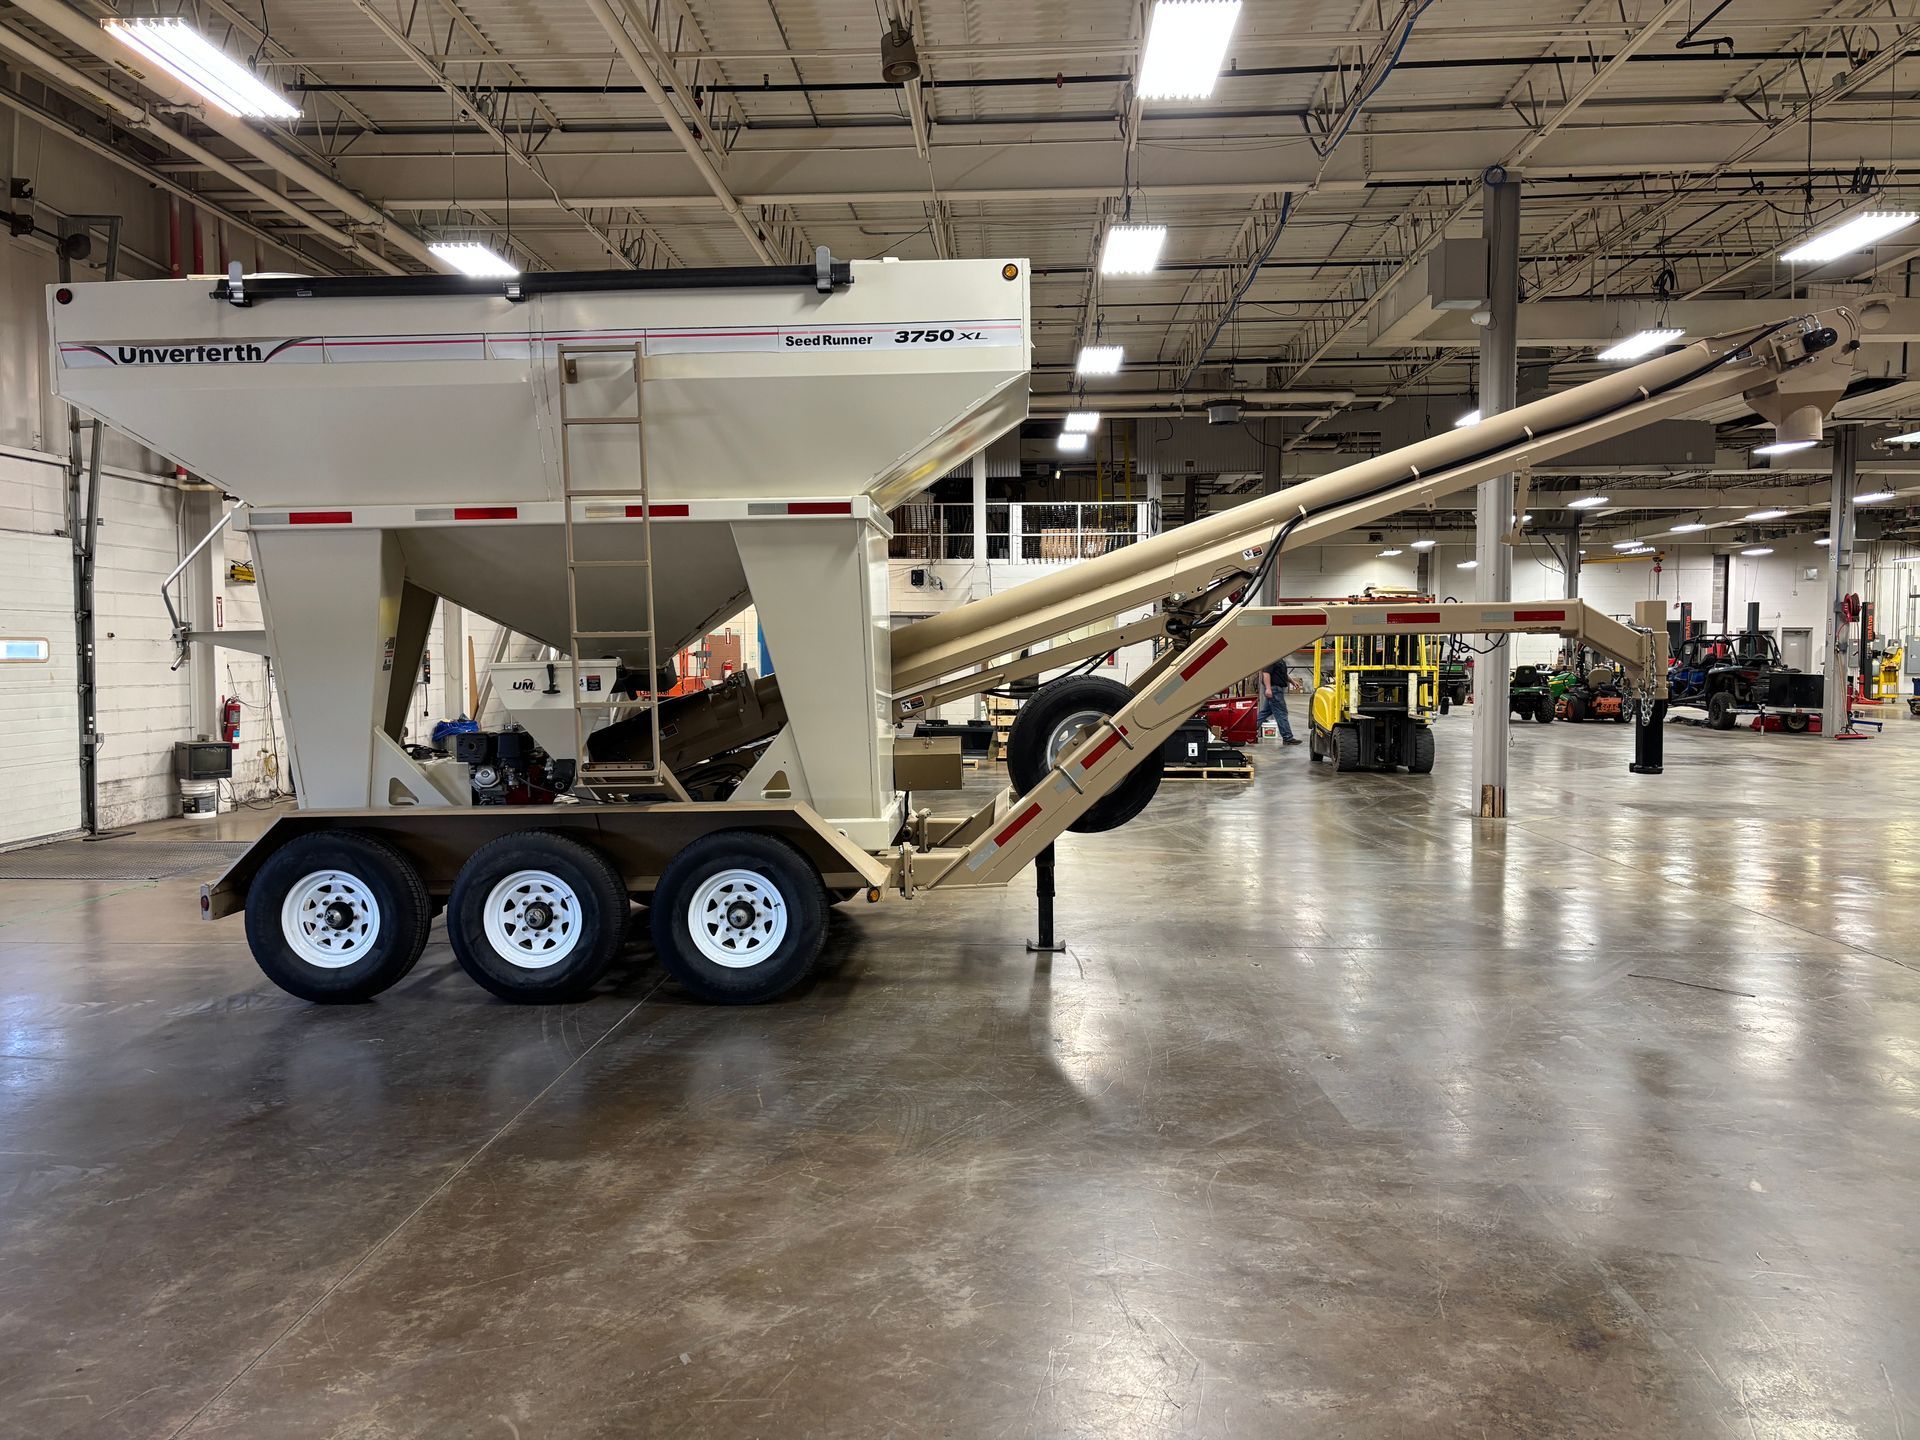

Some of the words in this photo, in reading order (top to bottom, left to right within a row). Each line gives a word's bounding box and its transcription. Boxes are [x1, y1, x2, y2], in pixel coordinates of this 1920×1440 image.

[785, 335, 821, 347] Seed
[823, 334, 873, 346] Runner
[894, 329, 955, 344] 3750
[957, 331, 988, 341] XL
[118, 344, 262, 364] Unverferth
